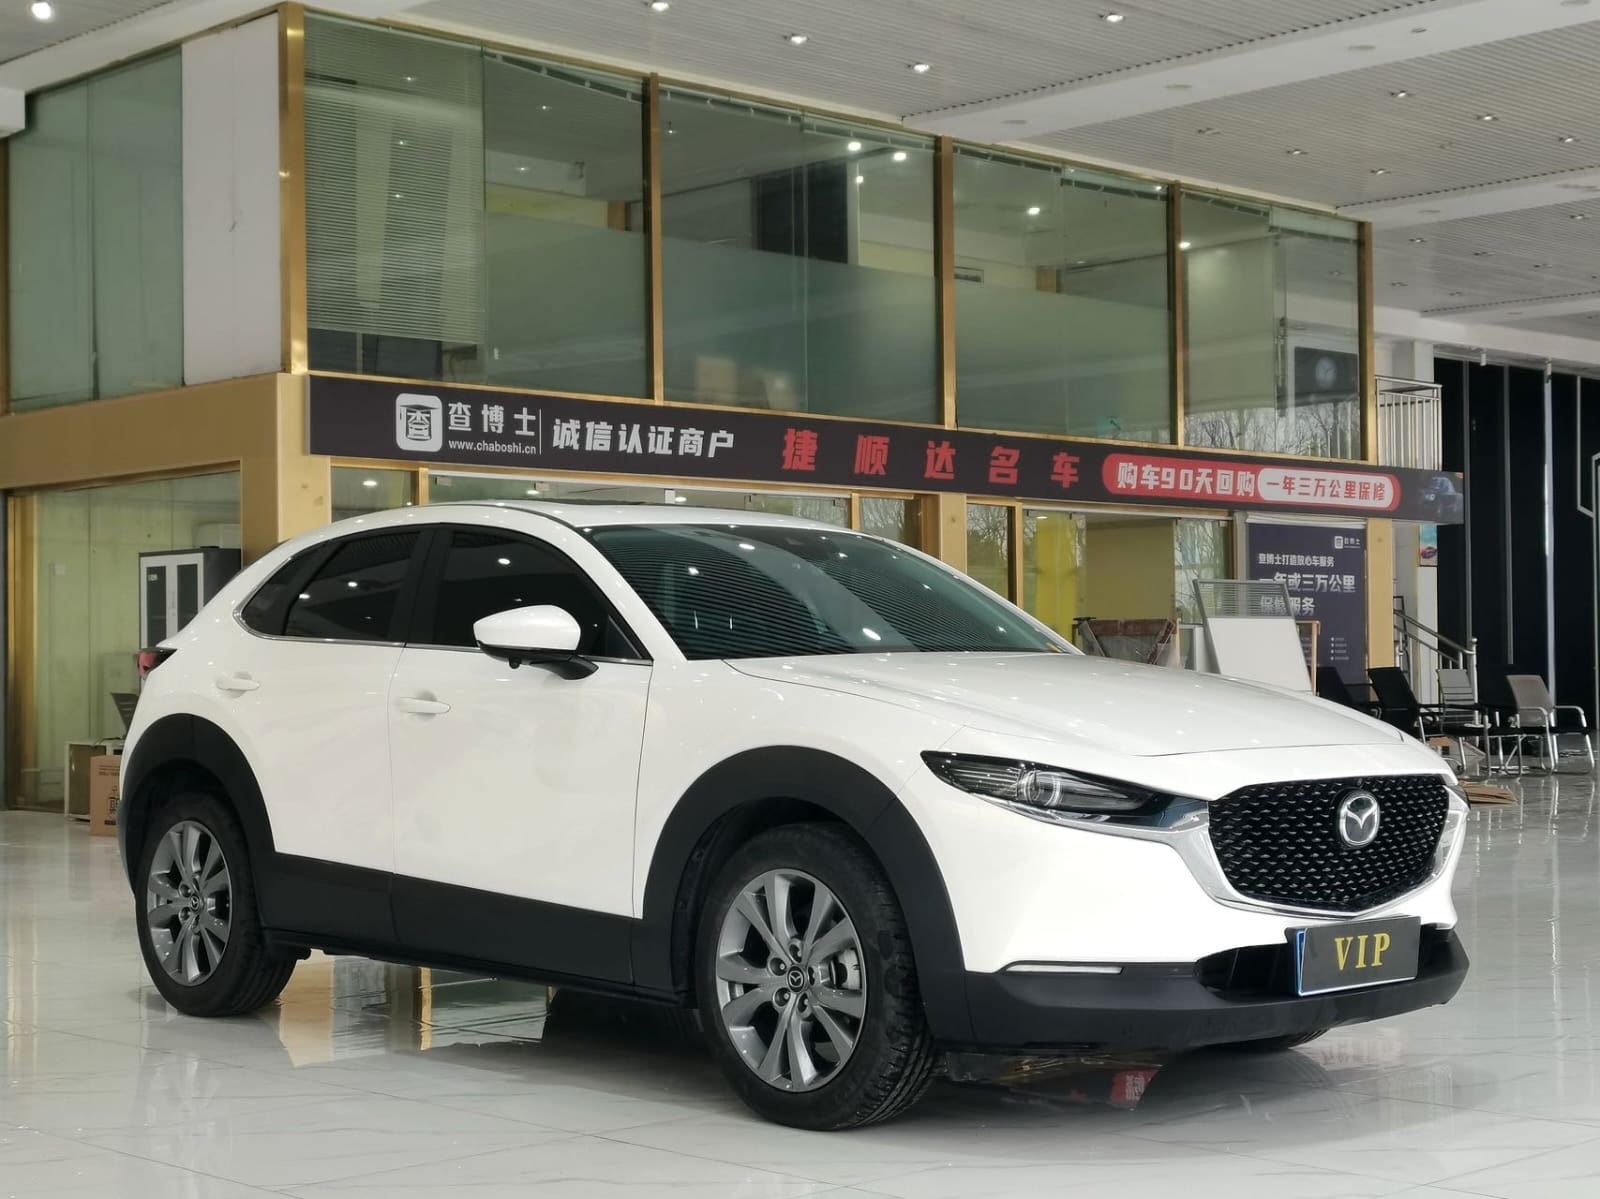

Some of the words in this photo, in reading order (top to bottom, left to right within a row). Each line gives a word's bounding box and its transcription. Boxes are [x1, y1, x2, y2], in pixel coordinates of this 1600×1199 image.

[448, 402, 536, 436] 查博士
[448, 440, 537, 455] www.chaboshi.cn
[553, 418, 735, 458] 诚信认证商户
[782, 428, 1080, 489] 捷顺达名车
[1117, 462, 1256, 497] 购车90天回购
[1266, 475, 1386, 501] 一年三万公里保修
[1334, 932, 1391, 971] VIP
